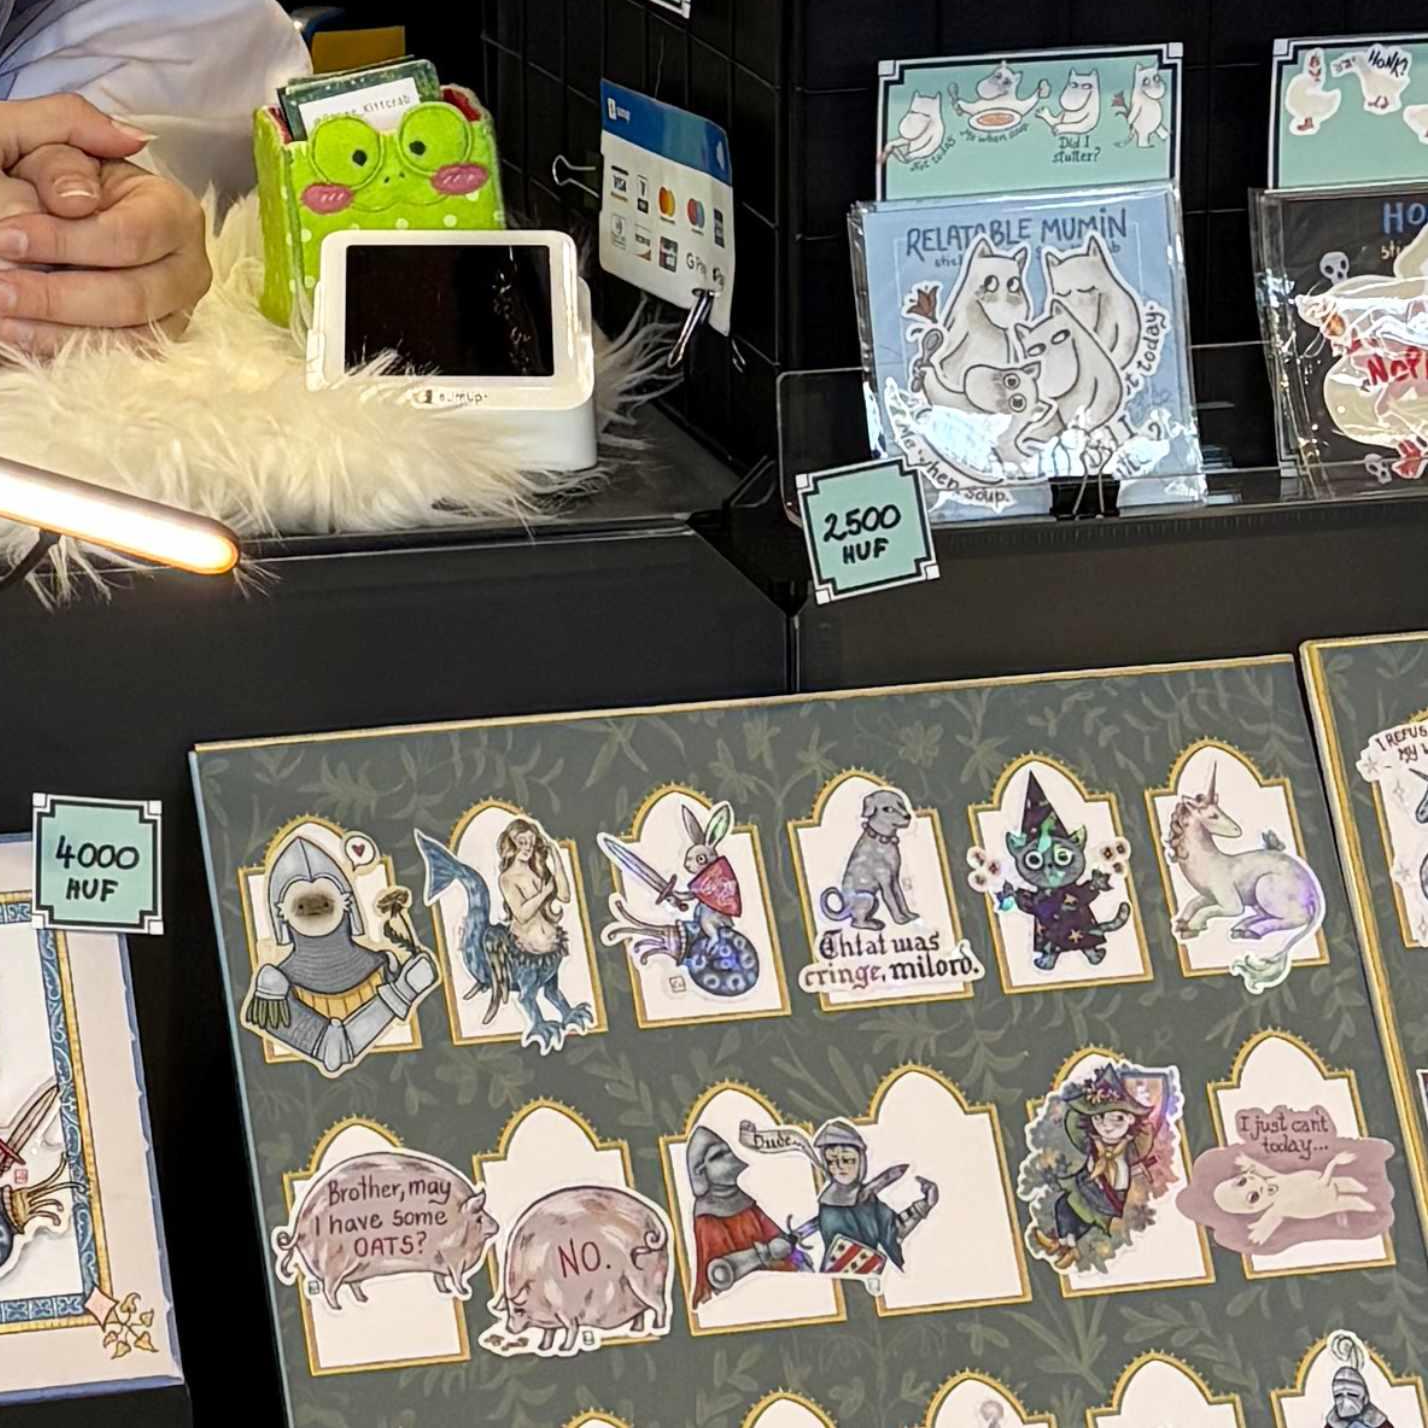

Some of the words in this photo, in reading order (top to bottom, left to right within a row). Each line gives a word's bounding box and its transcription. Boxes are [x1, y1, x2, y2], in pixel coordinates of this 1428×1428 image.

[906, 217, 1033, 261] RELATABLE
[823, 503, 901, 542] 2500
[842, 538, 890, 563] HUF
[56, 837, 139, 870] 4000
[66, 874, 118, 903] HUF
[893, 932, 940, 954] was
[804, 961, 886, 990] cringe,
[889, 952, 980, 978] milord.
[1240, 1116, 1250, 1134] I
[1256, 1115, 1286, 1138] just
[327, 1177, 403, 1205] Brother,
[408, 1178, 452, 1205] may
[315, 1213, 323, 1237] I
[334, 1211, 383, 1233] have
[394, 1208, 447, 1229] some
[354, 1231, 426, 1257] OATS?
[560, 1239, 612, 1274] NO.
